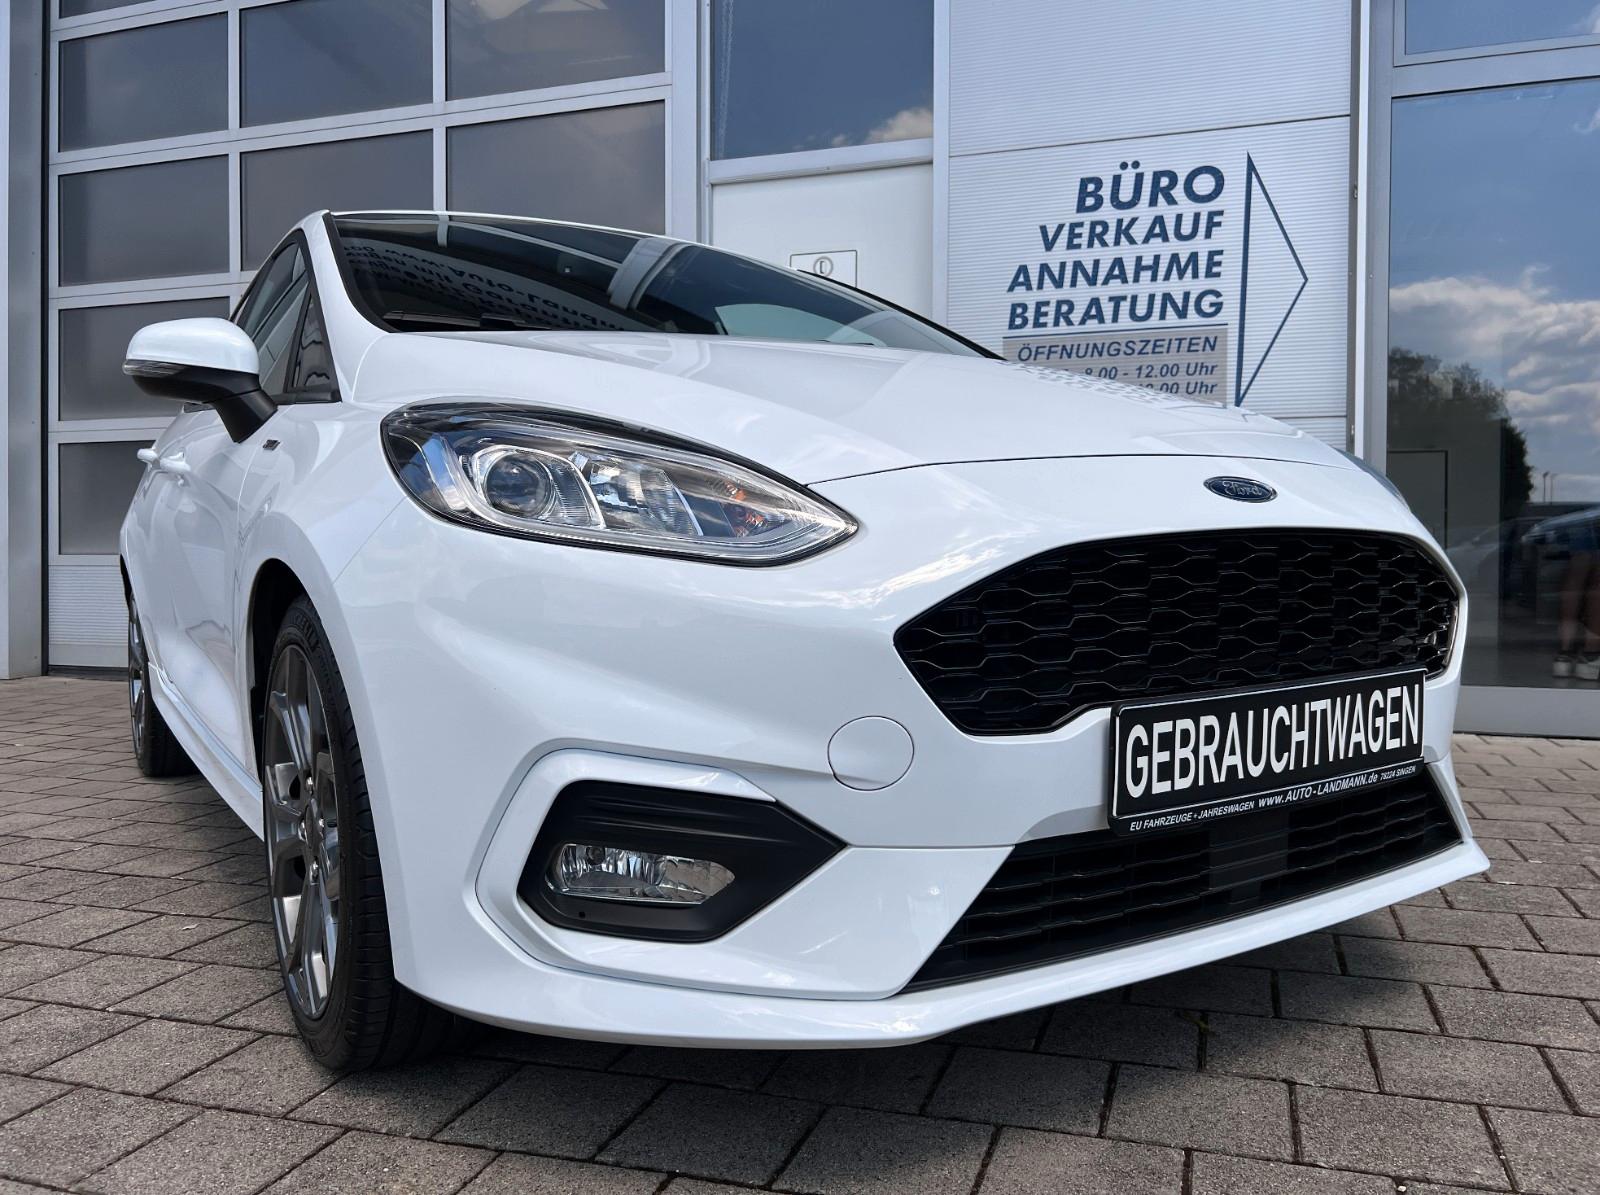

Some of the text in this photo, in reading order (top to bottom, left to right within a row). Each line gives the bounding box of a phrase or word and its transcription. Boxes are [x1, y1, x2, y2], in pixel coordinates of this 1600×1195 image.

[1076, 160, 1225, 214] BÜRO
[1039, 210, 1224, 252] VERKAUF
[1007, 250, 1224, 292] ANNAHME
[1007, 289, 1224, 330] BERATUNG
[1017, 336, 1218, 362] ÖFFNUNGSZEITEN
[1136, 363, 1180, 378] 12.00
[1185, 362, 1218, 377] Uhr
[1185, 381, 1218, 395] Uhr
[1222, 480, 1263, 496] Ford
[1125, 684, 1420, 798] GEBRAUCHTWAGEN
[1130, 821, 1142, 831] EU
[1143, 812, 1193, 829] FAHRZEUGE
[1197, 800, 1255, 819] JAHRESWAGEN
[1396, 765, 1416, 777] SINGEN
